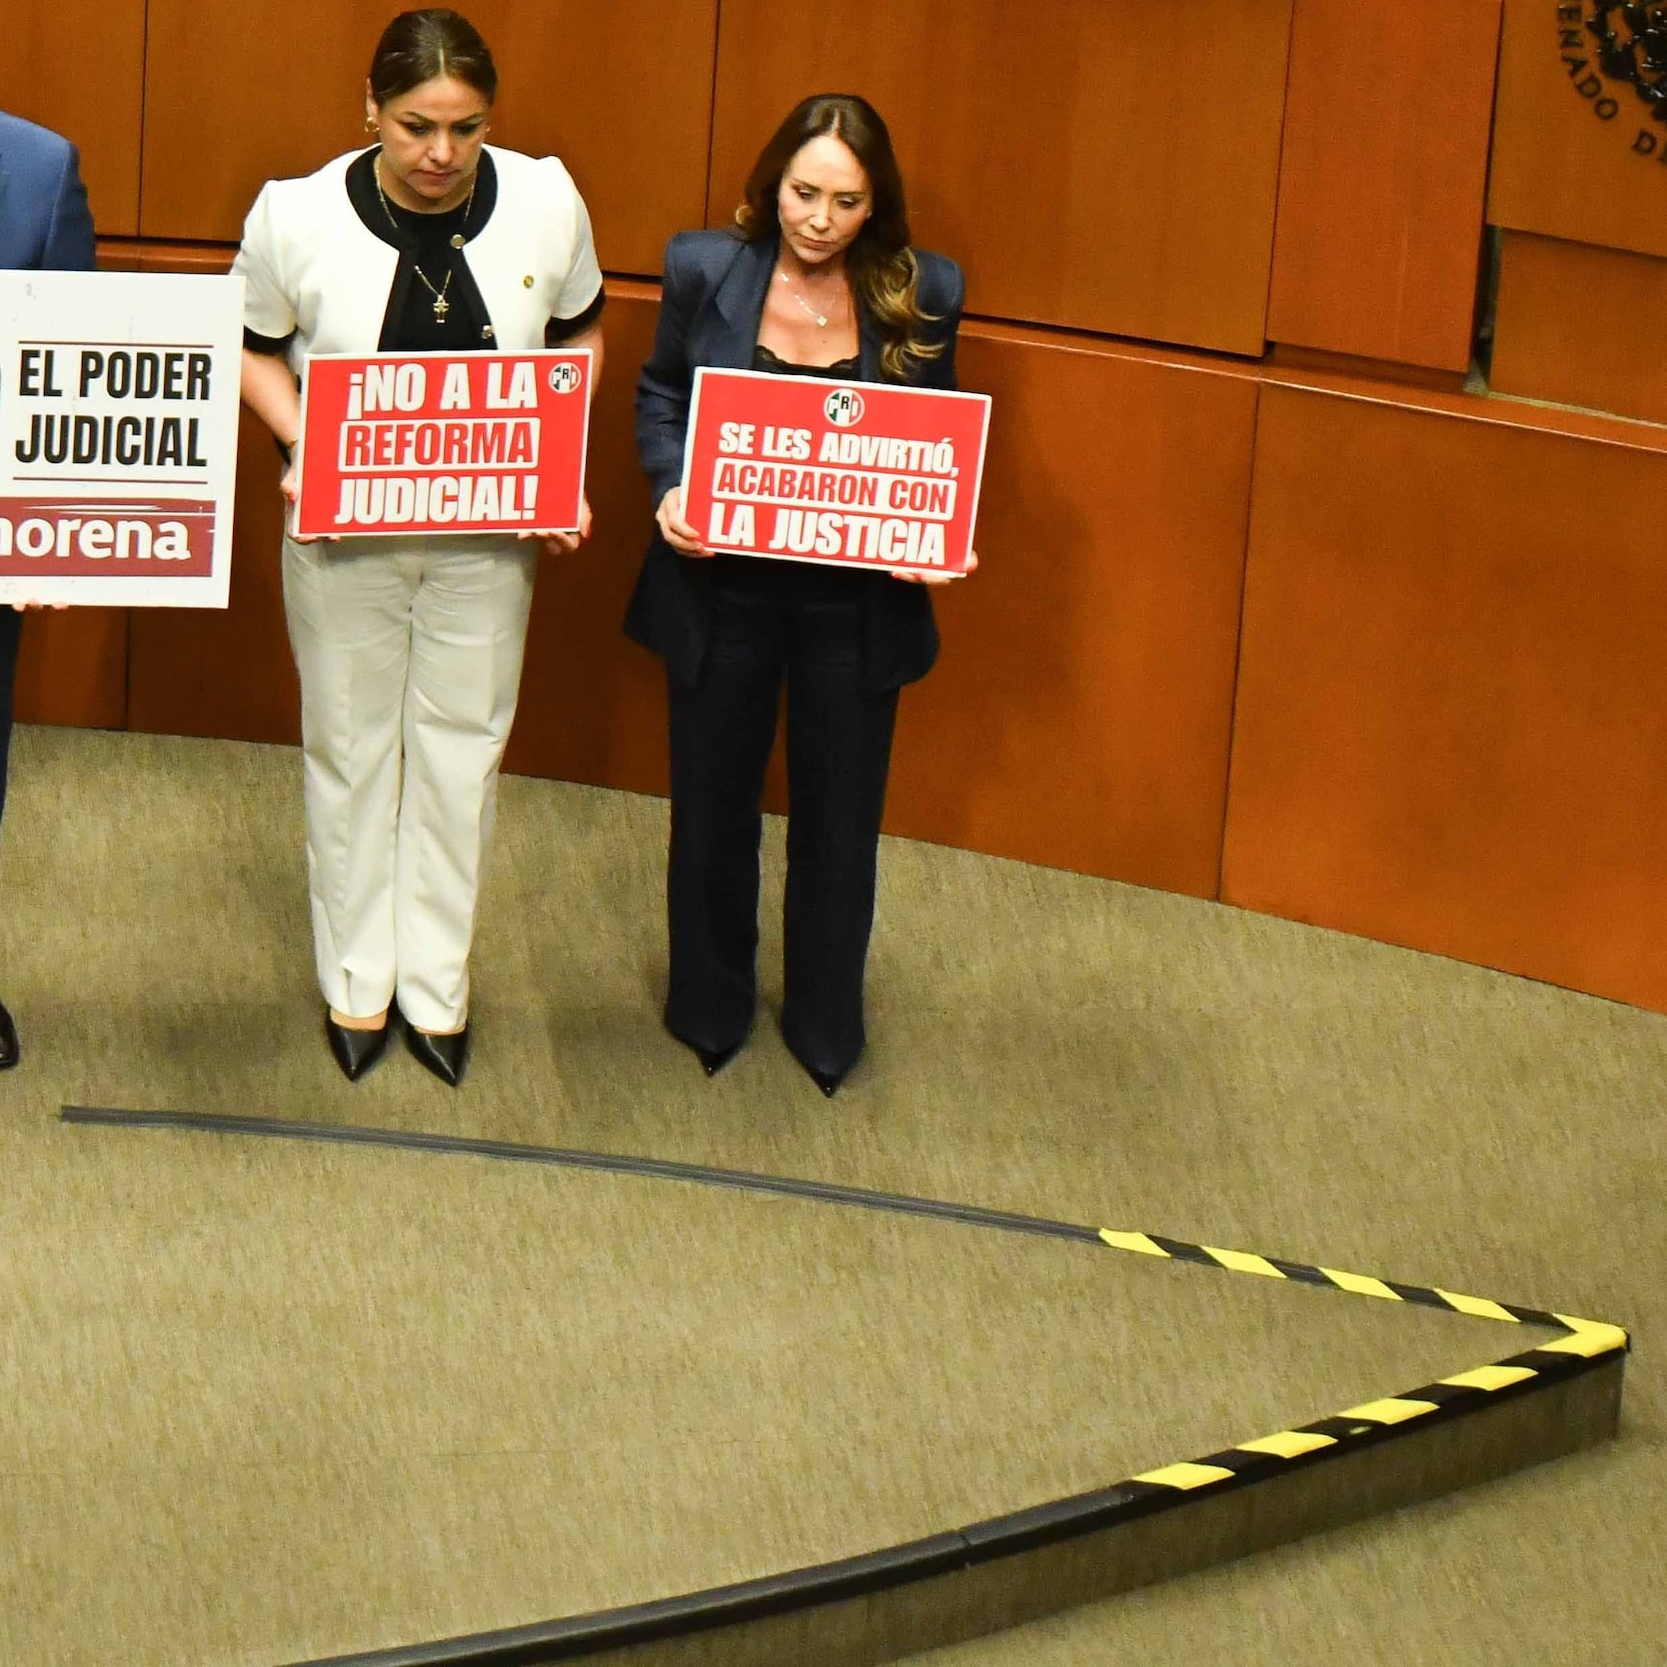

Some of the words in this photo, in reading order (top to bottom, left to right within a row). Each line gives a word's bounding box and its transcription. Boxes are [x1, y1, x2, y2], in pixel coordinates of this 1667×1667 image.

[18, 348, 63, 397] EL
[78, 350, 212, 401] PODER
[346, 363, 427, 420] ¡NO
[439, 362, 471, 410] A
[485, 361, 538, 410] LA
[14, 414, 208, 468] JUDICIAL
[344, 421, 535, 468] REFORMA
[718, 421, 756, 455] SE
[761, 425, 812, 460] LES
[818, 431, 959, 478] ADVIRTIÓ,
[333, 474, 540, 525] JUDICIAL!
[716, 463, 879, 507] ACABARON
[888, 478, 950, 514] CON
[707, 501, 756, 547] LA
[768, 507, 946, 566] JUSTICIA
